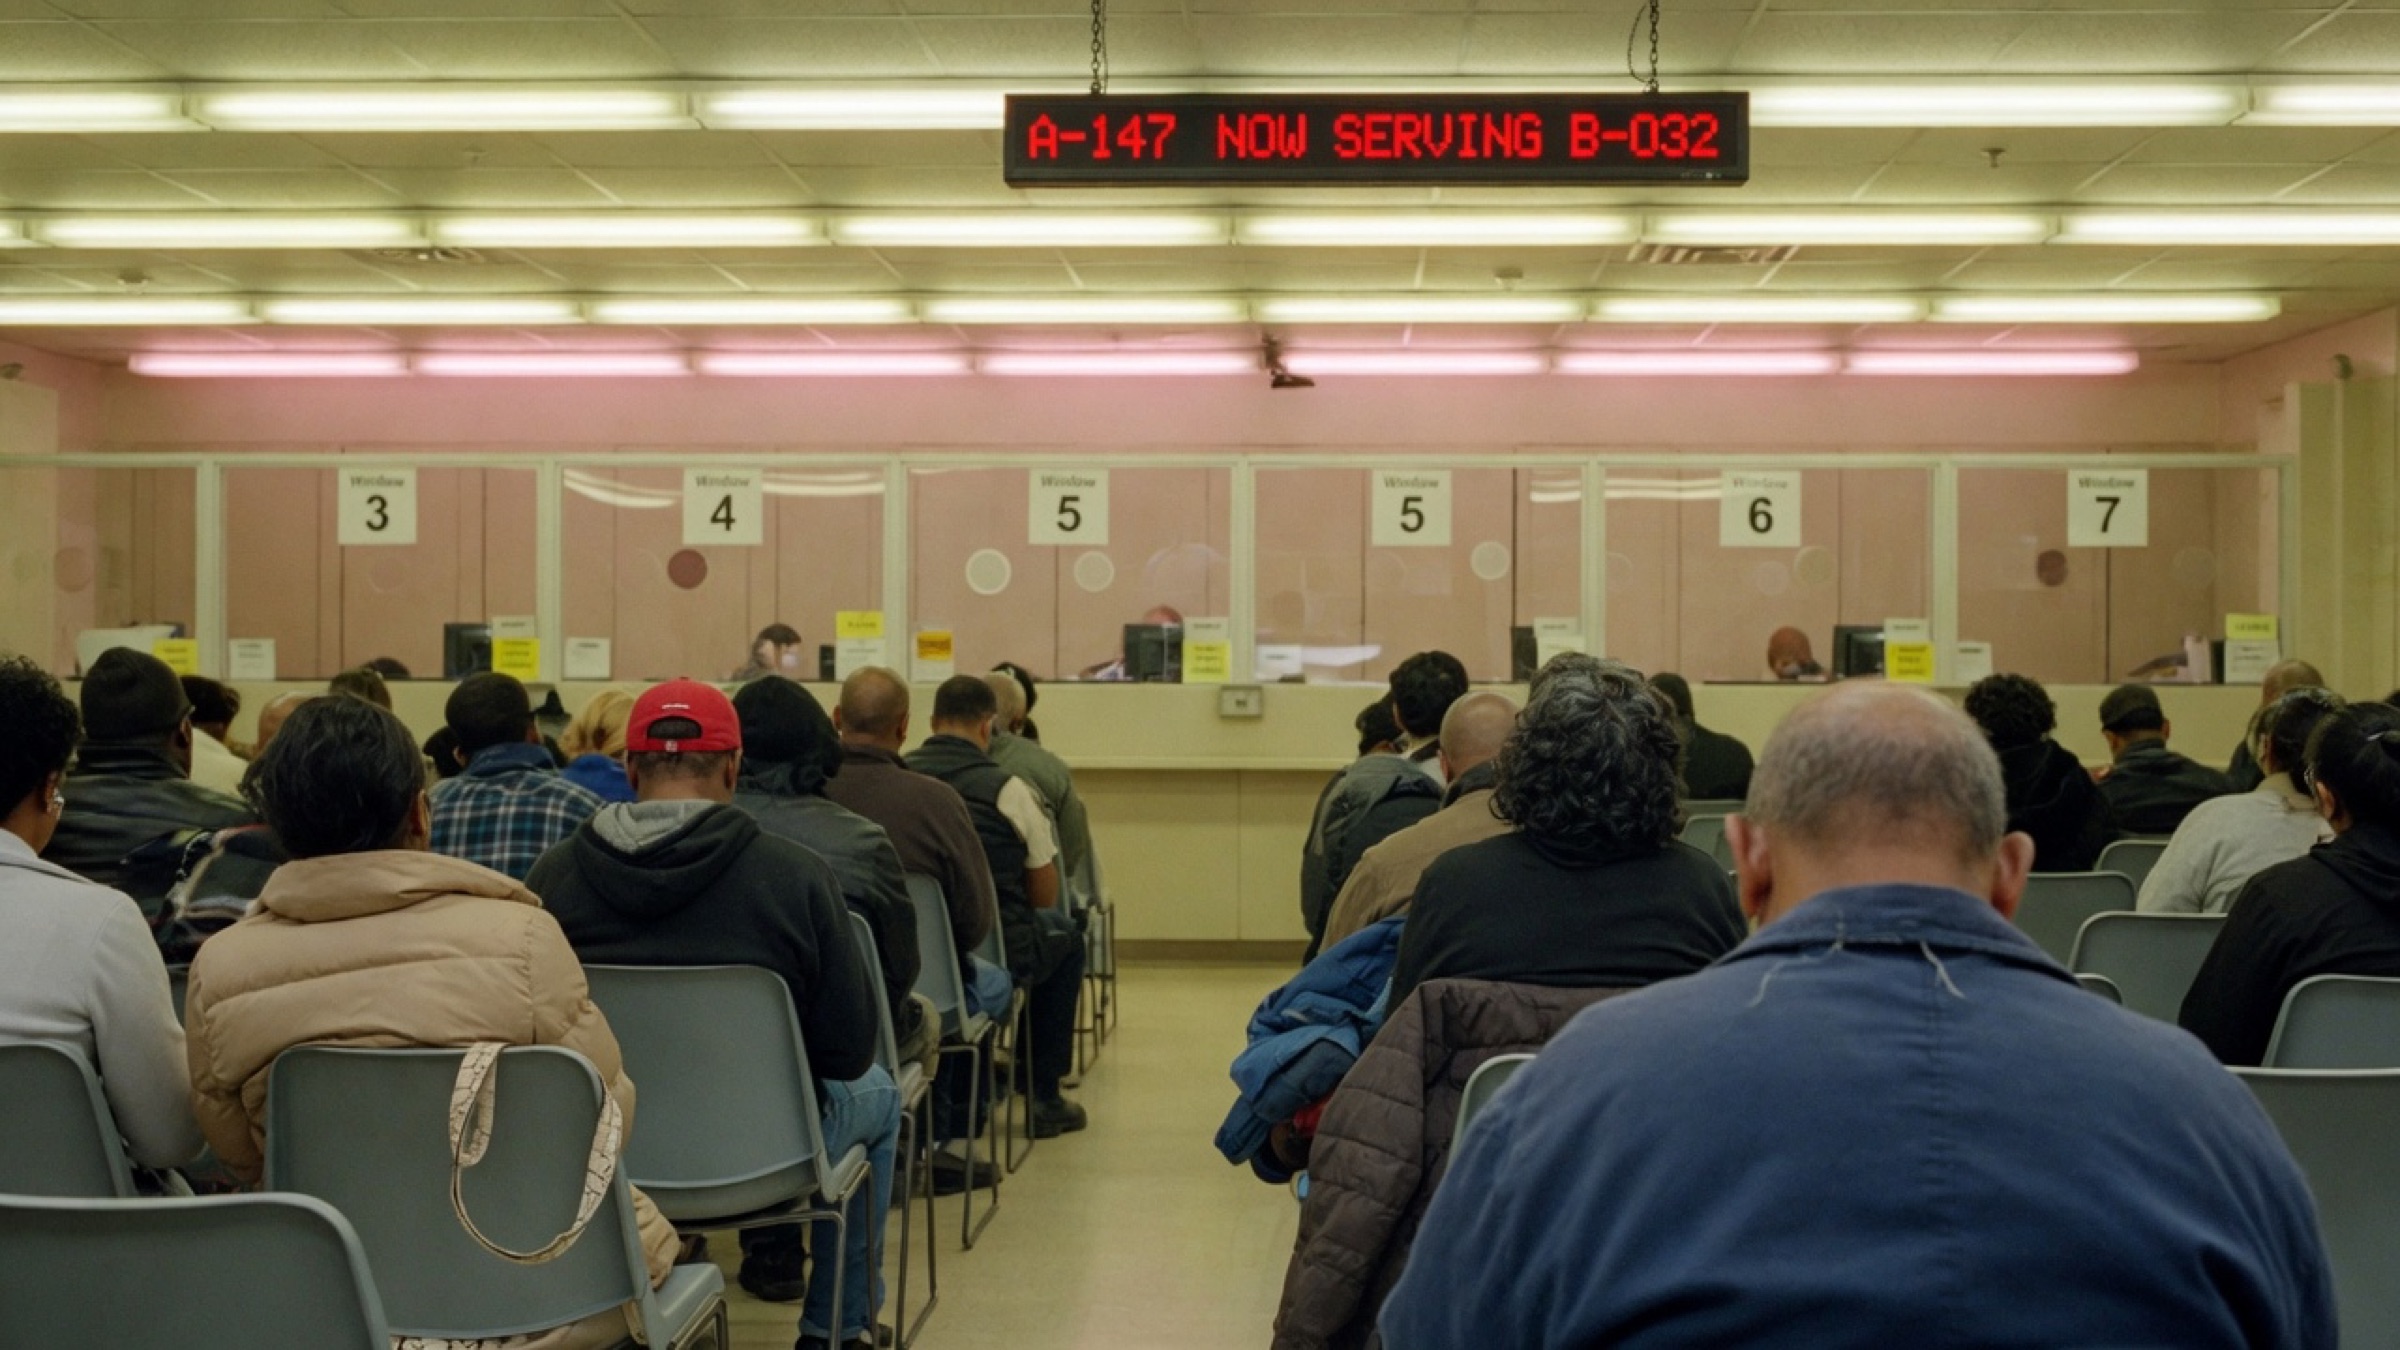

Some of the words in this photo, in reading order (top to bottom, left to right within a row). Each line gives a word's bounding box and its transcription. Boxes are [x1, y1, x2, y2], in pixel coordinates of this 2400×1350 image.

[1027, 112, 1177, 160] A-147
[1216, 112, 1308, 160] NOW
[1333, 111, 1543, 160] SERVING
[1569, 111, 1720, 160] B-032
[366, 494, 390, 532] 3
[710, 494, 736, 532] 4
[1056, 494, 1082, 533] 5
[1401, 495, 1426, 534] 5
[1748, 496, 1774, 535] 6
[2096, 495, 2122, 534] 7
